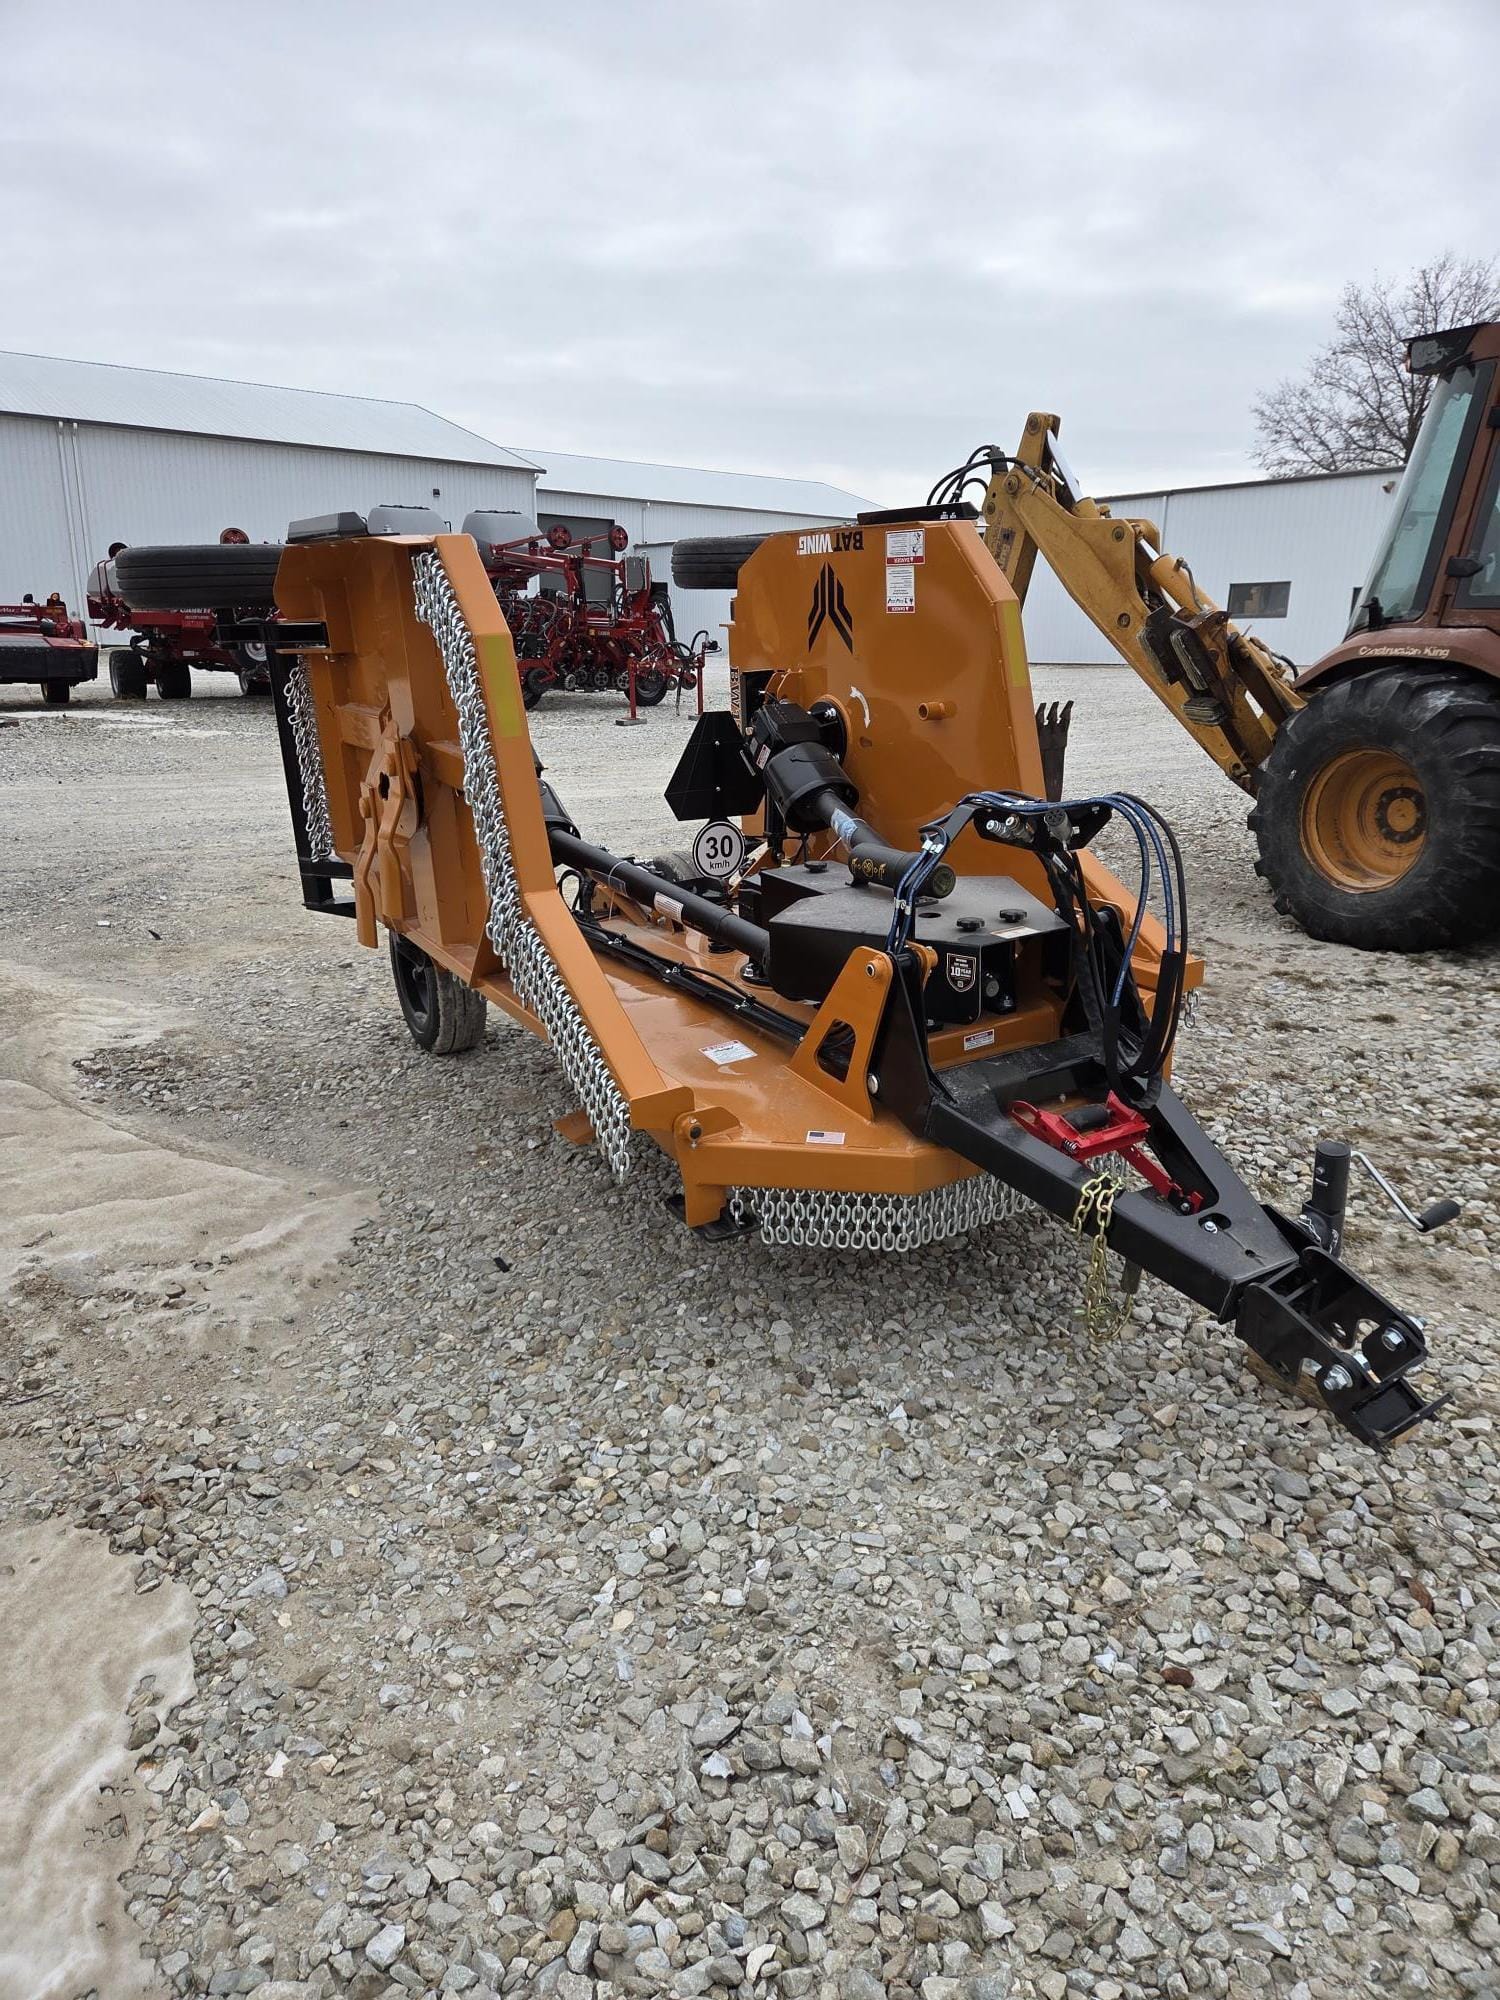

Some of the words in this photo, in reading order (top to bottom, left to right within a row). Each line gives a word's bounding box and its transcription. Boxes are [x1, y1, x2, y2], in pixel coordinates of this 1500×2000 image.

[1359, 646, 1421, 657] Construction
[1423, 646, 1450, 659] King
[706, 835, 733, 860] 30
[710, 860, 730, 870] km/h
[950, 966, 961, 977] 10
